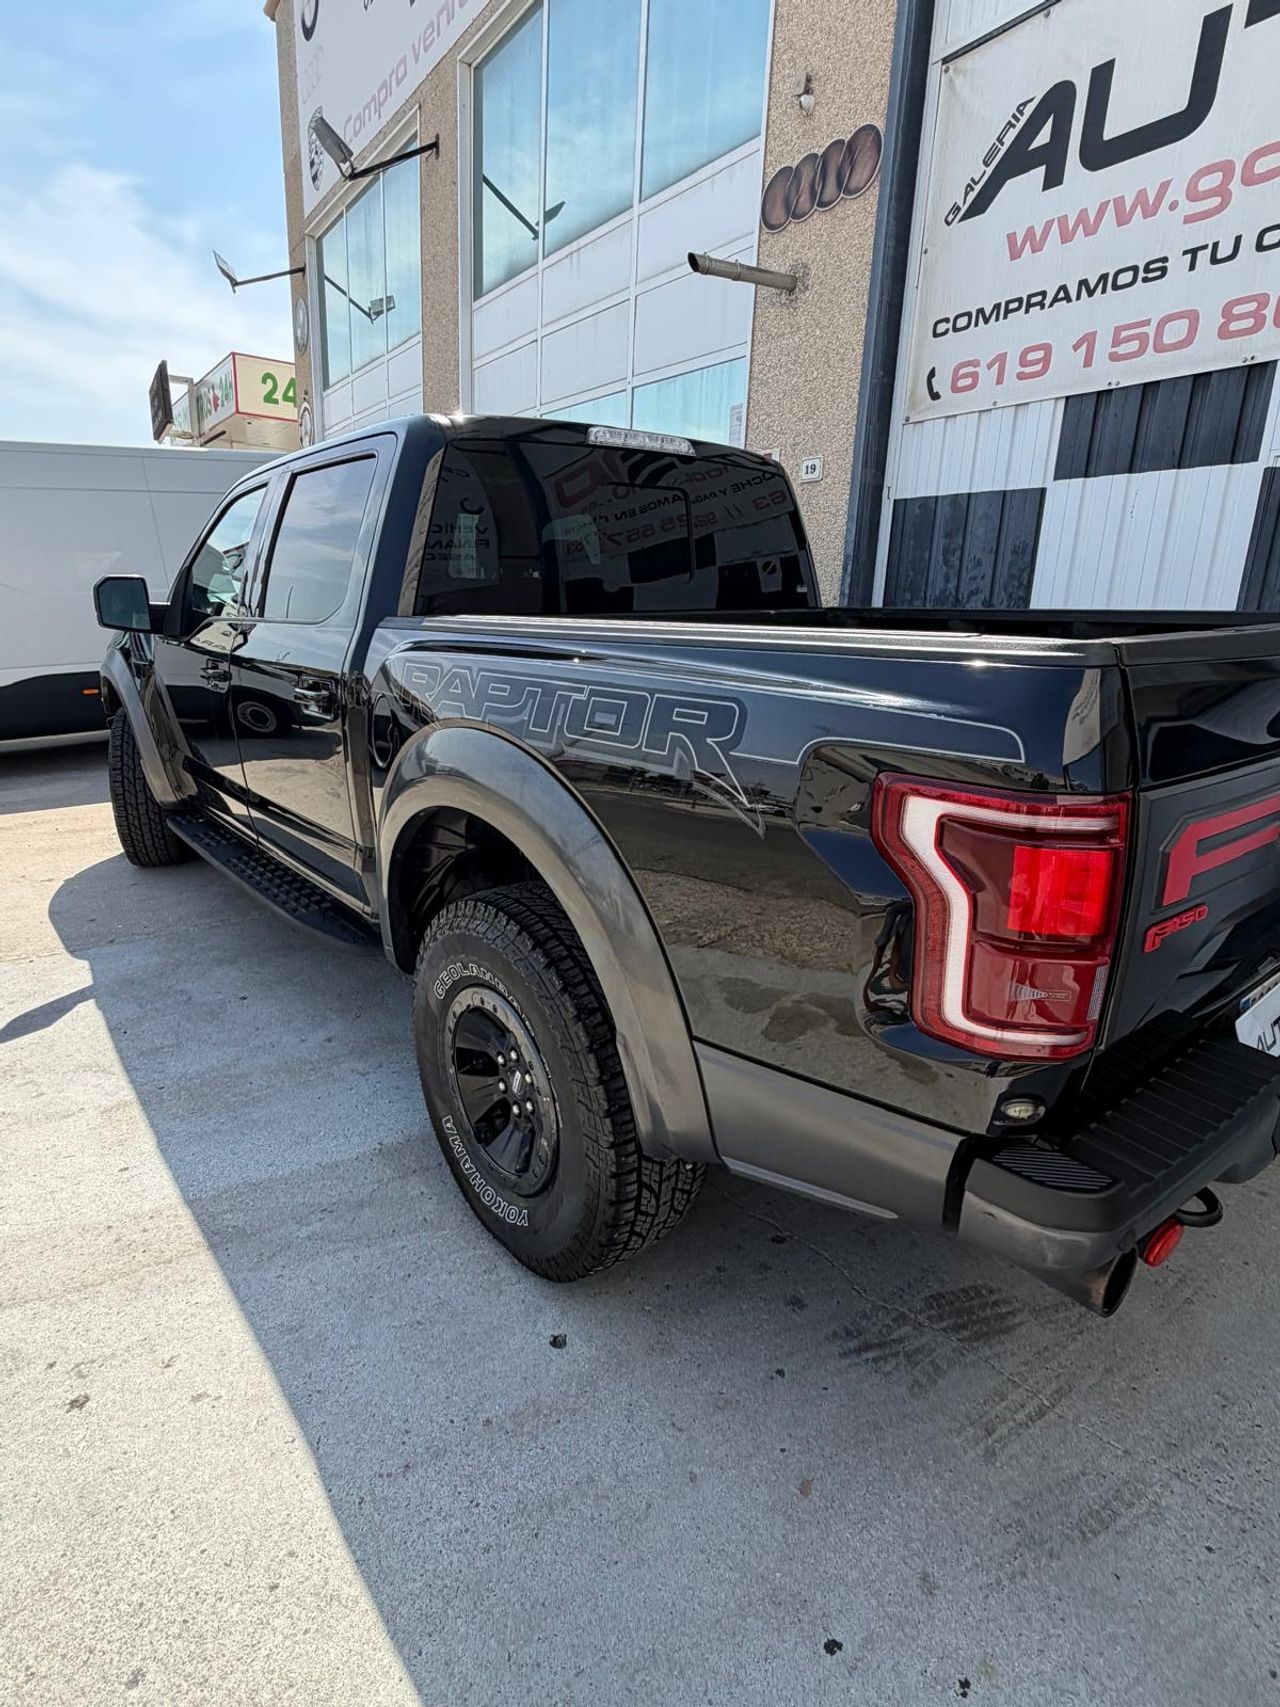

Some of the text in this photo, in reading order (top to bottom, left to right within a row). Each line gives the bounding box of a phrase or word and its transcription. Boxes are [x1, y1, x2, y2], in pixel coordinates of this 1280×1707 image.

[944, 96, 1037, 227] GALERIA
[932, 256, 1169, 338] COMPRAMOS
[1182, 234, 1242, 272] TU
[261, 371, 297, 408] 24
[950, 292, 1280, 394] 619 150 8
[805, 463, 817, 475] 19
[401, 661, 756, 810] RAPTOR
[442, 1115, 529, 1227] YOKOHAMA
